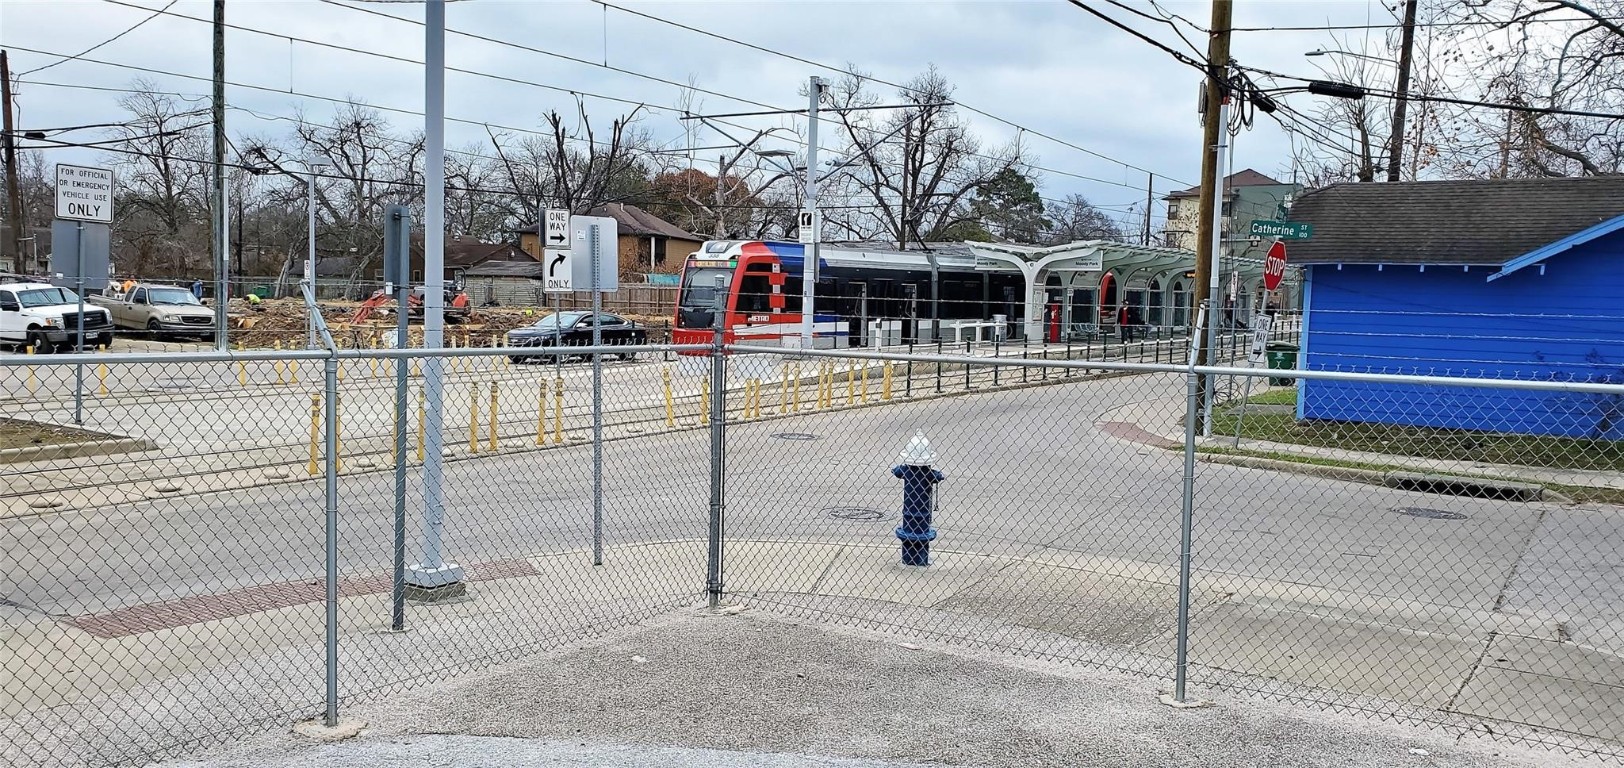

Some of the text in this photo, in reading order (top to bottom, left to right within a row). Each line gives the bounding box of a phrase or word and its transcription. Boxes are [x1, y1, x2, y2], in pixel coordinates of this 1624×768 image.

[61, 168, 108, 179] FOR OFFICIAL
[72, 181, 110, 190] EMERGENCY
[62, 191, 89, 199] VEHICLE
[68, 202, 101, 216] ONLY
[549, 212, 566, 221] ONE
[549, 222, 566, 231] WAY
[1252, 223, 1295, 235] Catherine
[1266, 256, 1285, 276] STOP
[548, 280, 569, 289] ONLY
[1258, 318, 1269, 331] ONE
[1255, 331, 1267, 343] WAY
